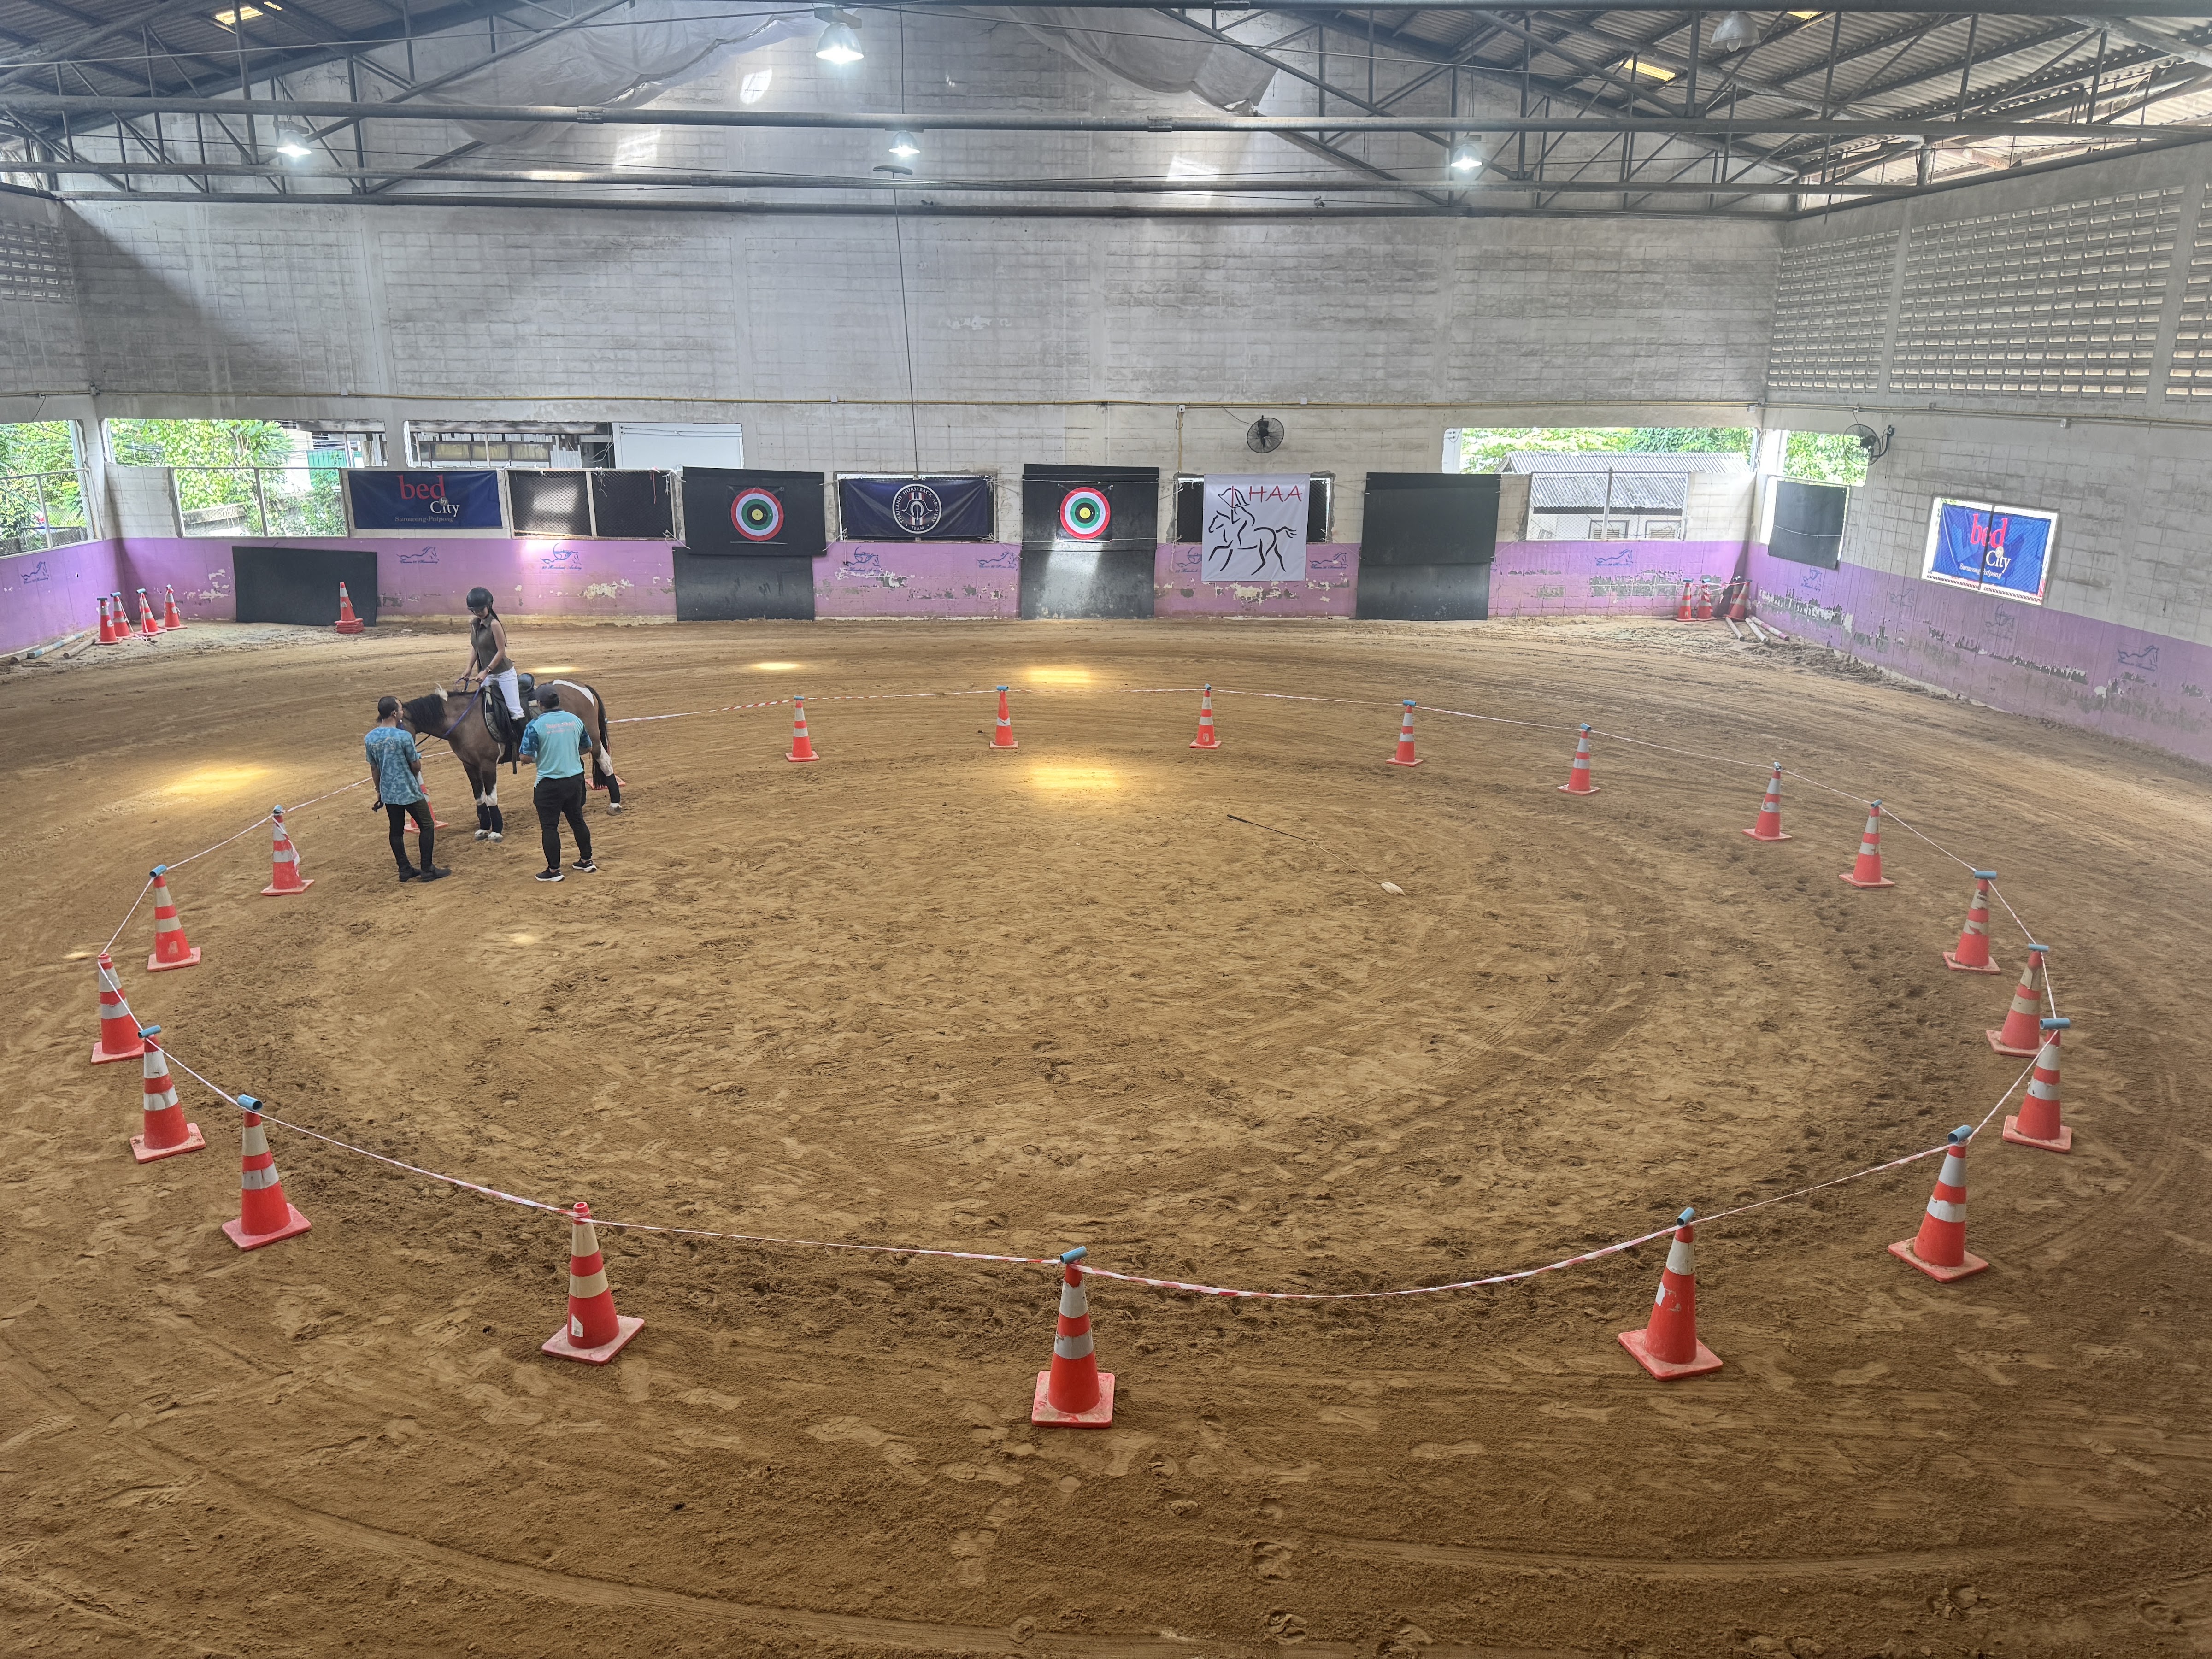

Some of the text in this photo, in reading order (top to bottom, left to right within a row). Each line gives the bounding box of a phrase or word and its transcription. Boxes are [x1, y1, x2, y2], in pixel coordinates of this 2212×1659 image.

[397, 474, 445, 500] bed
[430, 501, 460, 517] City
[895, 495, 904, 524] THAILAND
[902, 487, 933, 498] HORSEBACK
[1986, 550, 2011, 574] City
